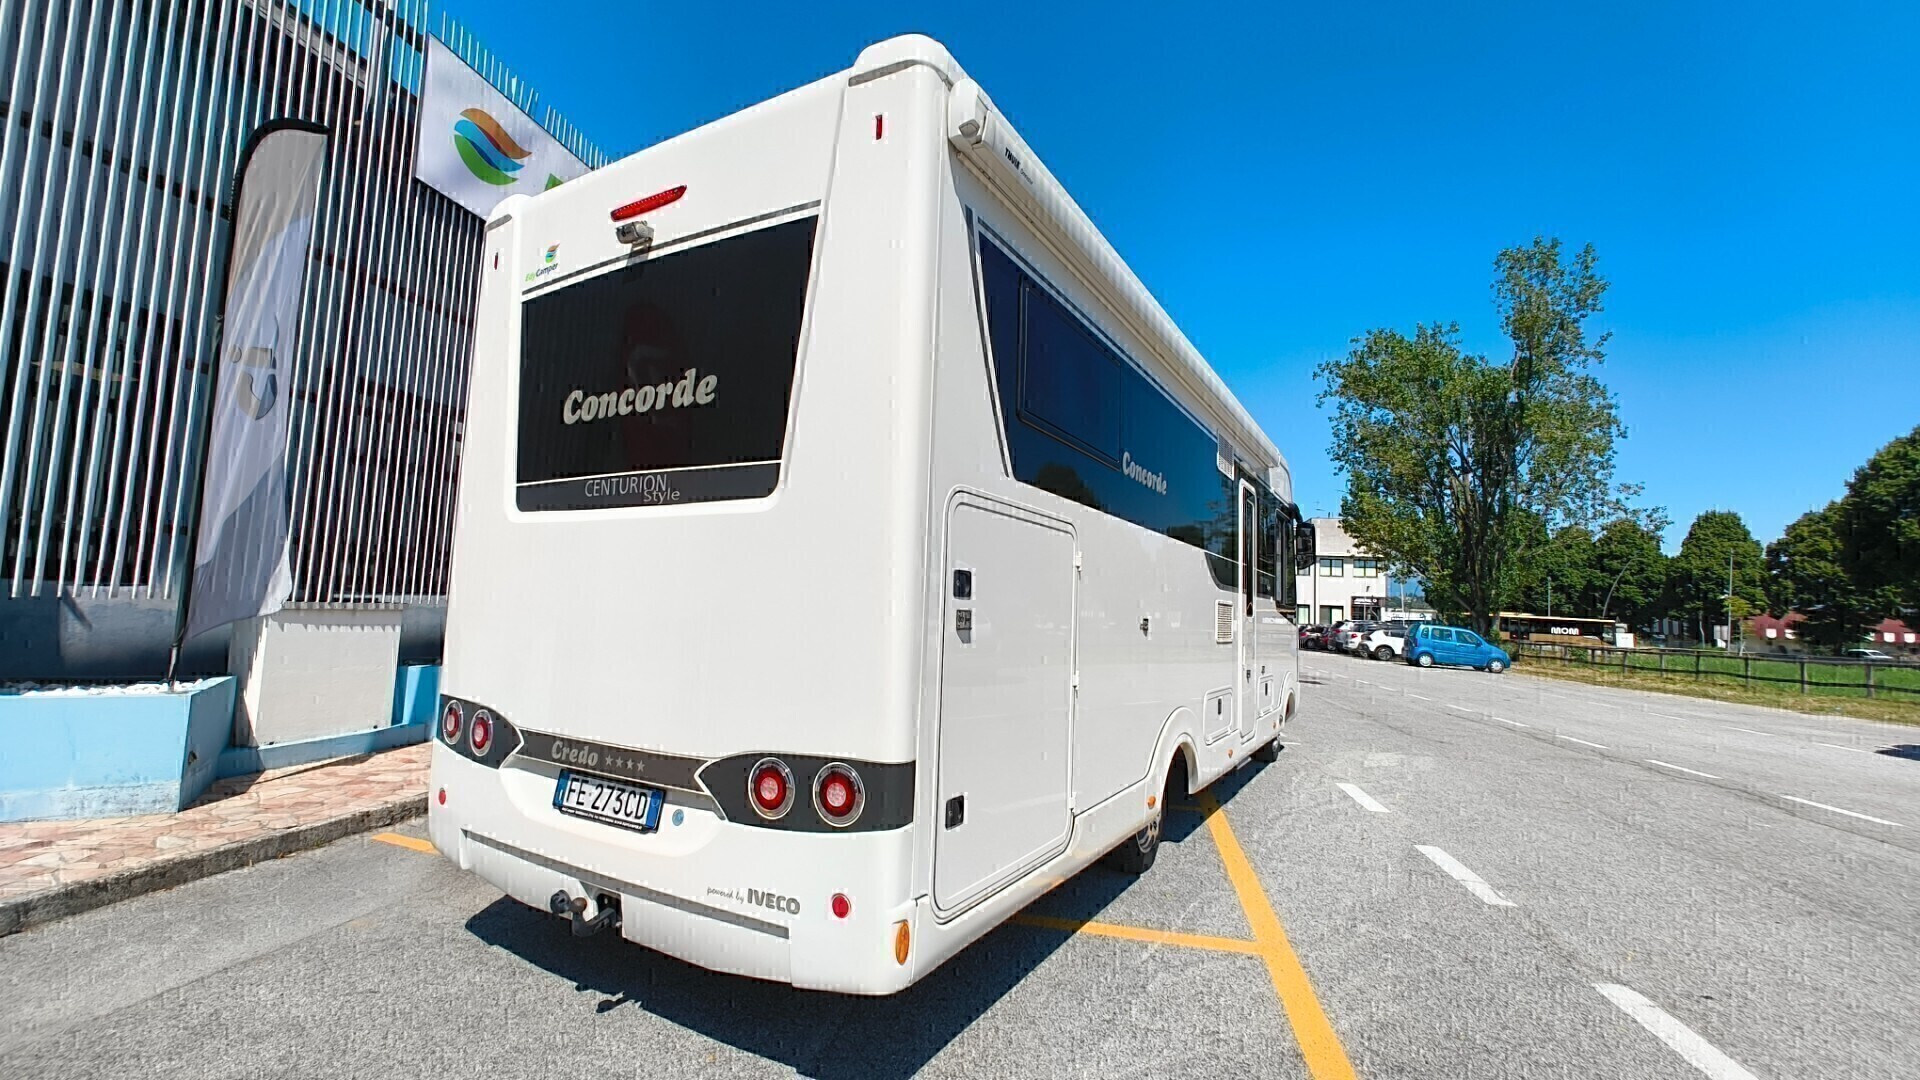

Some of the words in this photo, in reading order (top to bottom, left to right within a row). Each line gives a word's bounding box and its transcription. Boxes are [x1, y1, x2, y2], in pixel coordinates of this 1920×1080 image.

[563, 368, 718, 425] Concorde
[584, 474, 668, 497] CENTURION
[1122, 451, 1167, 496] Concorde
[643, 488, 681, 504] Style
[551, 740, 599, 767] Credo
[706, 886, 735, 899] powered
[747, 888, 801, 915] IVECO
